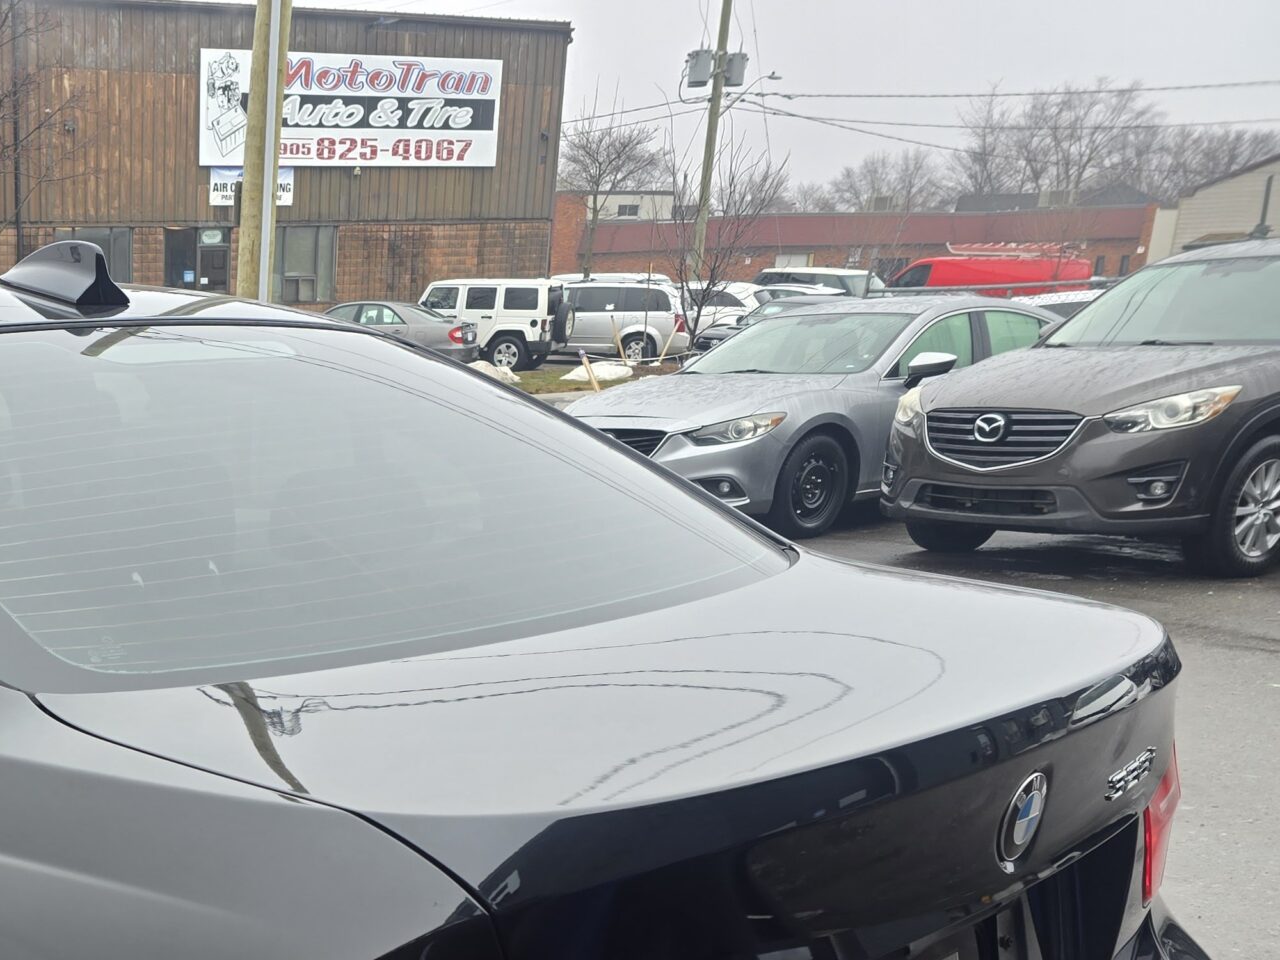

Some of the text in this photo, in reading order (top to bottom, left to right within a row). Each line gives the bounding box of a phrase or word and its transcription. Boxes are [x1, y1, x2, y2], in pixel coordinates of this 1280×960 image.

[283, 57, 492, 95] MotoTran
[282, 95, 474, 128] Auto & Tire
[316, 137, 473, 161] 825-4067
[212, 183, 229, 193] AIR
